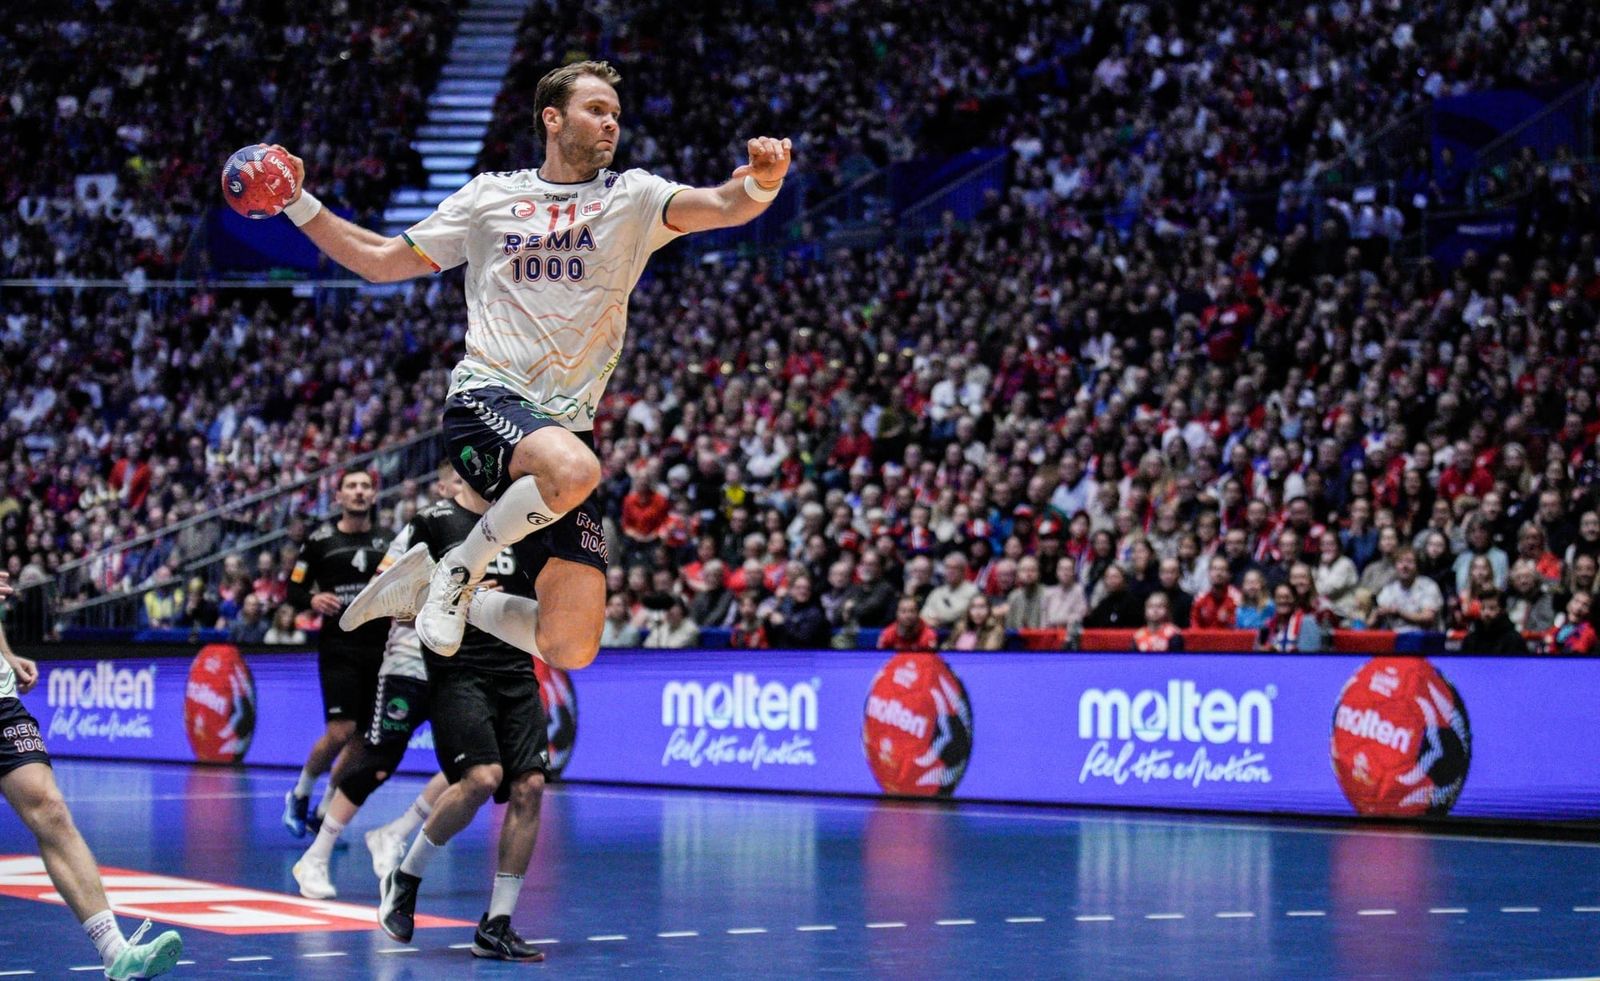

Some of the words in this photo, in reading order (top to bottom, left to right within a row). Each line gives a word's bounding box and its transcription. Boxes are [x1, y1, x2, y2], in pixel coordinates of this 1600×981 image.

[546, 203, 577, 232] 11
[502, 224, 597, 255] REMA
[510, 254, 585, 283] 1000
[351, 548, 367, 573] 4
[48, 661, 155, 710] molten
[662, 672, 818, 731] molten
[1078, 679, 1273, 744] molten
[3, 723, 42, 740] REM
[1335, 704, 1414, 754] molten
[14, 738, 48, 754] 100
